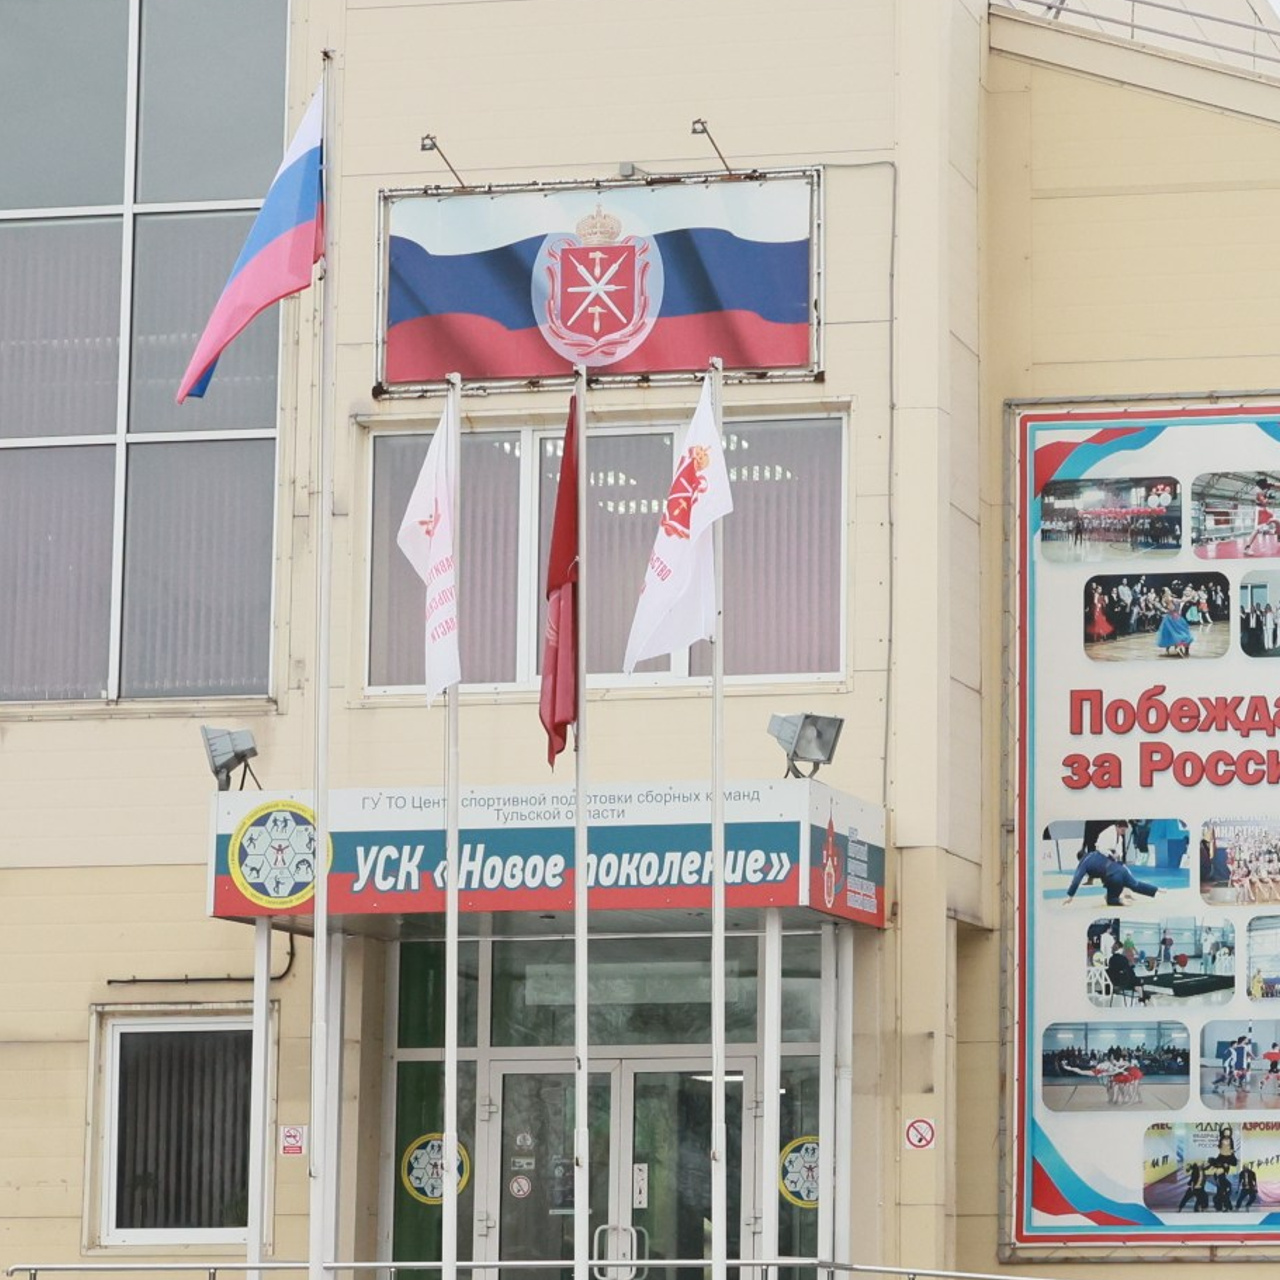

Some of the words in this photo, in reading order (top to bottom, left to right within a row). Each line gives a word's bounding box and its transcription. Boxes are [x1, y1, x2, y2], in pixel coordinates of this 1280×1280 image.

[1062, 753, 1121, 789] за
[361, 797, 382, 810] ГУ
[386, 796, 407, 809] ТО
[411, 795, 449, 811] Цент
[461, 793, 547, 810] спортивной
[551, 792, 633, 807] подотовки
[637, 789, 701, 805] сборных
[706, 789, 761, 803] кманд
[494, 807, 561, 824] Тульской
[565, 808, 626, 820] оласти
[353, 845, 425, 892] УСК
